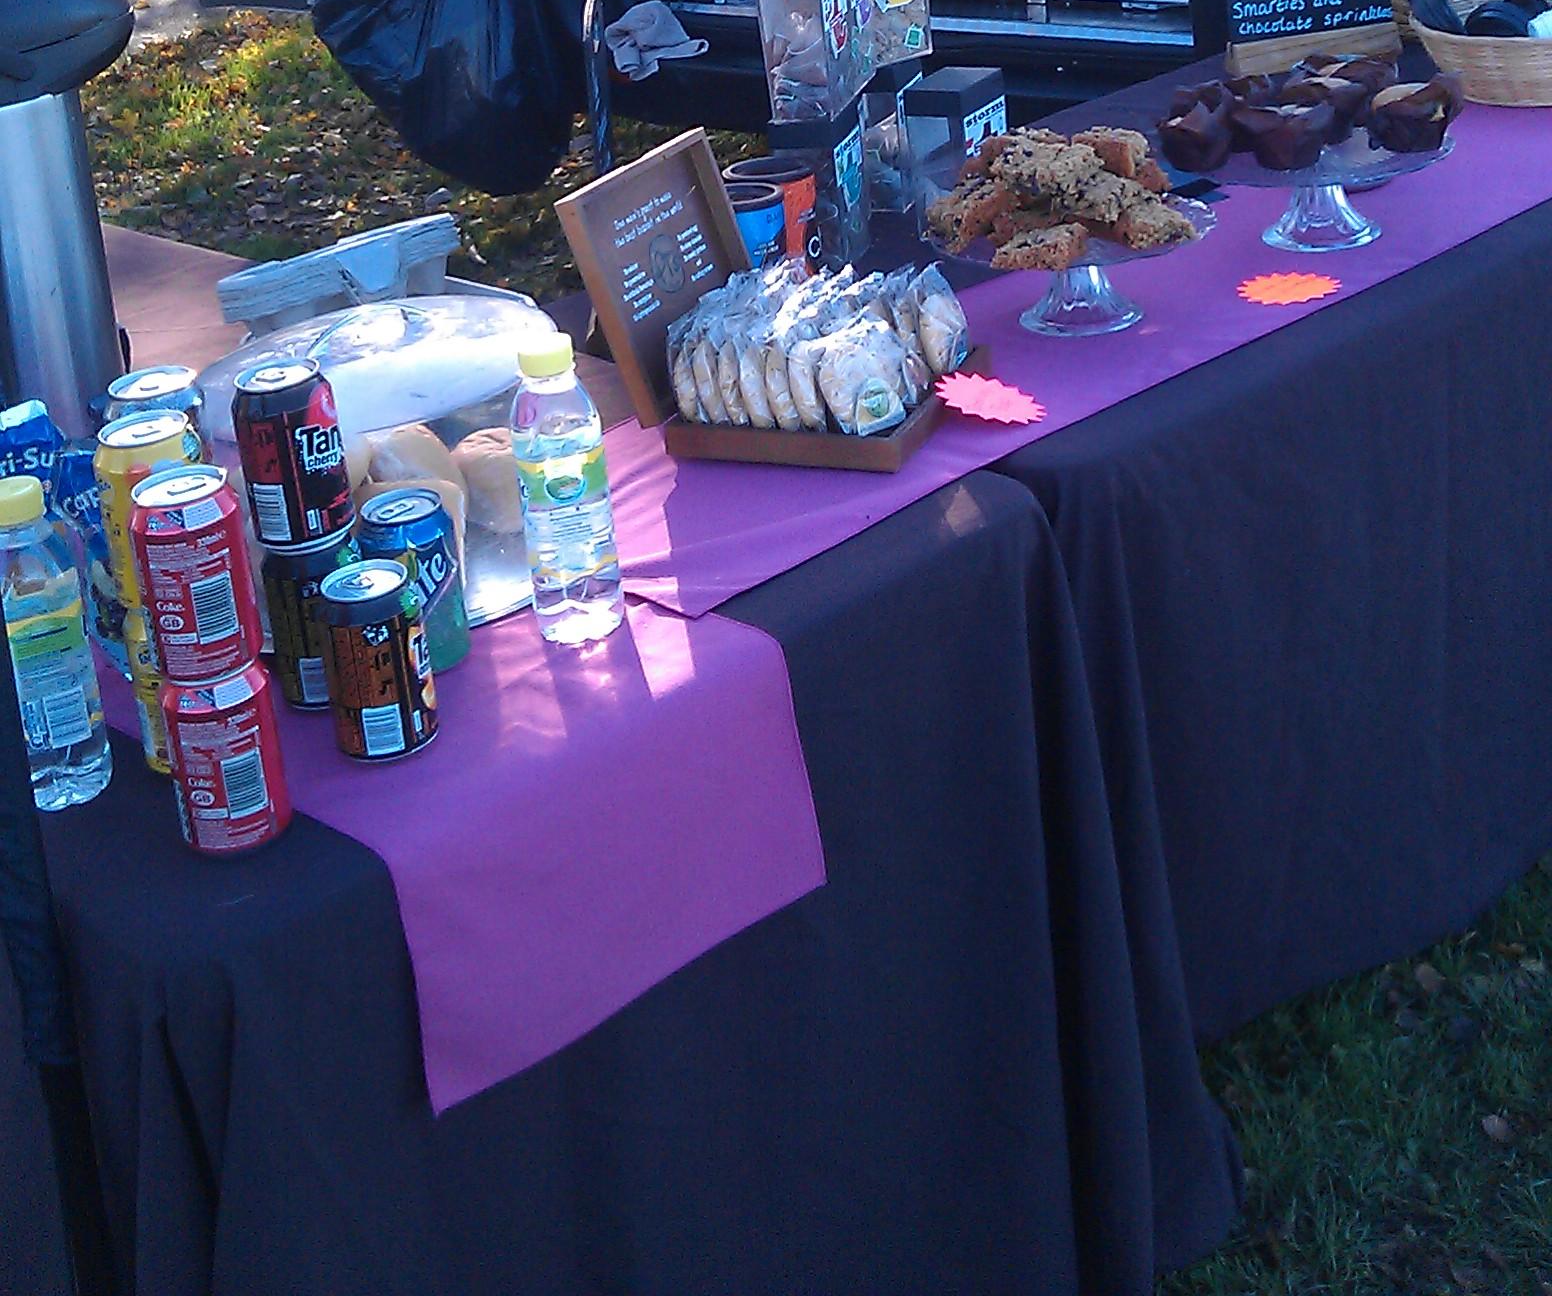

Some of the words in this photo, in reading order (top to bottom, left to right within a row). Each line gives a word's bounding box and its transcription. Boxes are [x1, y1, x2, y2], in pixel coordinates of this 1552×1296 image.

[1238, 15, 1313, 35] chocolate
[1323, 5, 1394, 27] sprinkles
[965, 101, 1004, 128] storm
[296, 425, 340, 457] Tan
[307, 451, 338, 468] cherry
